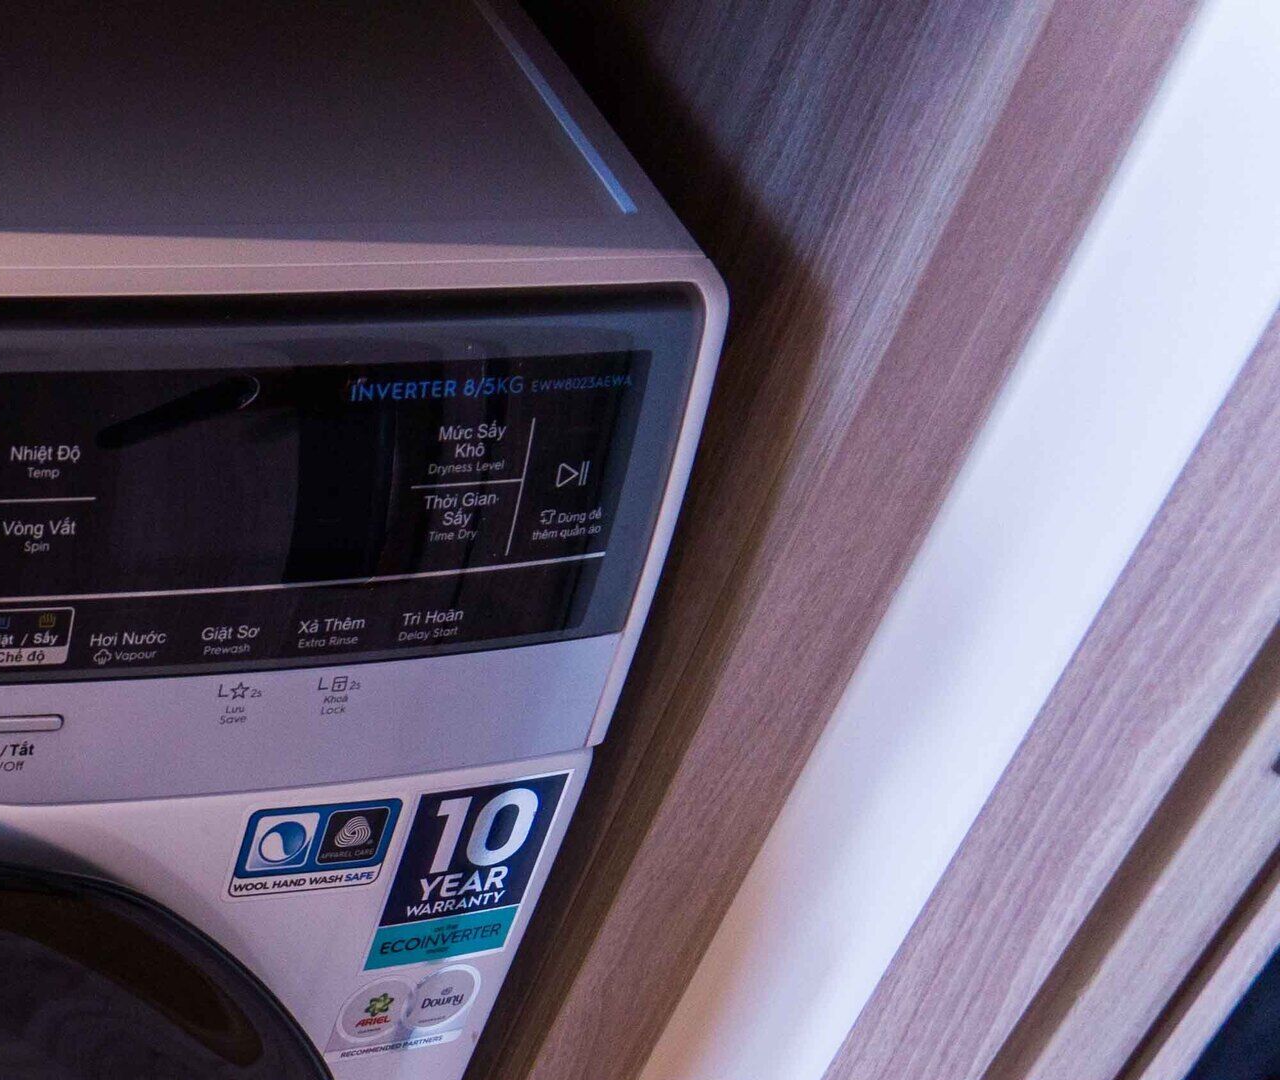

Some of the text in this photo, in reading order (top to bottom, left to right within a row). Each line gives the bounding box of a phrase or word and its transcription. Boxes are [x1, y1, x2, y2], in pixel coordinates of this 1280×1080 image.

[349, 375, 525, 402] INVERTER 8/5KG
[438, 419, 507, 442] Mức Sấy
[9, 444, 81, 464] Nhiệt Độ
[454, 442, 485, 459] Khô
[26, 466, 60, 479] Temp
[428, 460, 505, 477] Dryness Level
[424, 491, 497, 510] Thời Gian
[442, 506, 472, 527] Sấy
[3, 516, 76, 539] Vòng Vắt
[428, 529, 478, 542] Time Dry
[24, 541, 50, 554] Spin
[324, 616, 366, 632] Thêm
[424, 607, 464, 624] Hoãn
[33, 630, 58, 646] Sấy
[90, 629, 167, 647] Hơi Nước
[201, 624, 261, 643] Giặt Sơ
[297, 635, 359, 649] Extra Rinse
[398, 625, 459, 642] Delay Start
[27, 650, 45, 663] độ
[114, 649, 157, 661] Vapour
[202, 643, 251, 656] Prewash
[320, 705, 347, 715] Lock
[219, 714, 248, 725] Save
[428, 788, 539, 874] 10
[319, 848, 375, 860] APPAREL CARE
[233, 871, 375, 892] WOOL HAND WASH SAFE
[419, 866, 509, 902] YEAR
[405, 889, 506, 918] WARRANTY
[380, 922, 502, 955] ECOINVERTER
[421, 993, 465, 1009] Downy
[355, 1015, 391, 1028] ARIEL
[340, 1035, 443, 1058] RECOMMENDED PARTNERS
